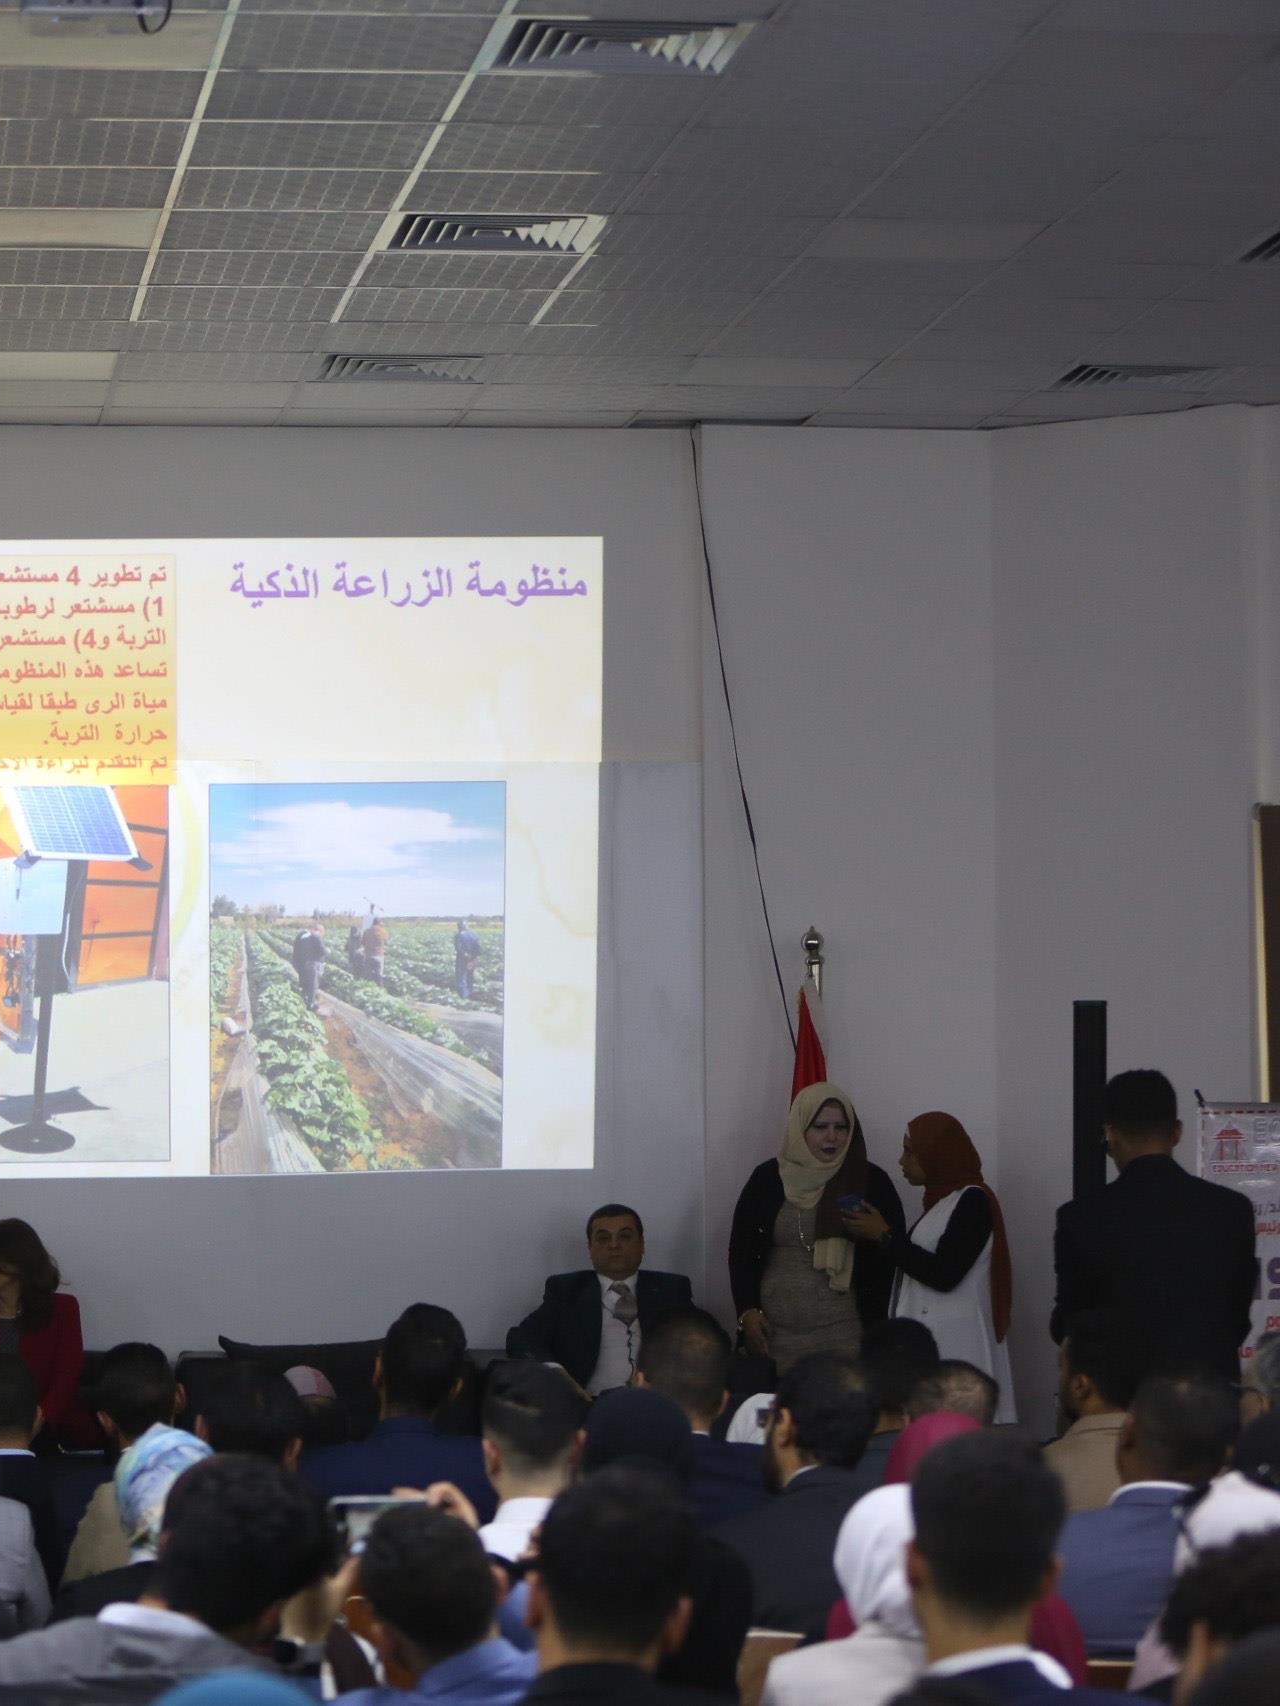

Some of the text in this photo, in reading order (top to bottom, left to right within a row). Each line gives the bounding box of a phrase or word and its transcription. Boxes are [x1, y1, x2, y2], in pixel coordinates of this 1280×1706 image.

[66, 566, 82, 587] 4
[89, 564, 143, 589] تطوير
[149, 566, 168, 591] تم
[231, 561, 588, 609] منظومة الزراعة الذكية
[117, 622, 167, 652] التربة
[75, 660, 105, 679] هذه
[114, 662, 168, 679] تساعد
[41, 692, 79, 716] طبقا
[86, 693, 126, 716] الرى
[116, 724, 169, 747] حرارة
